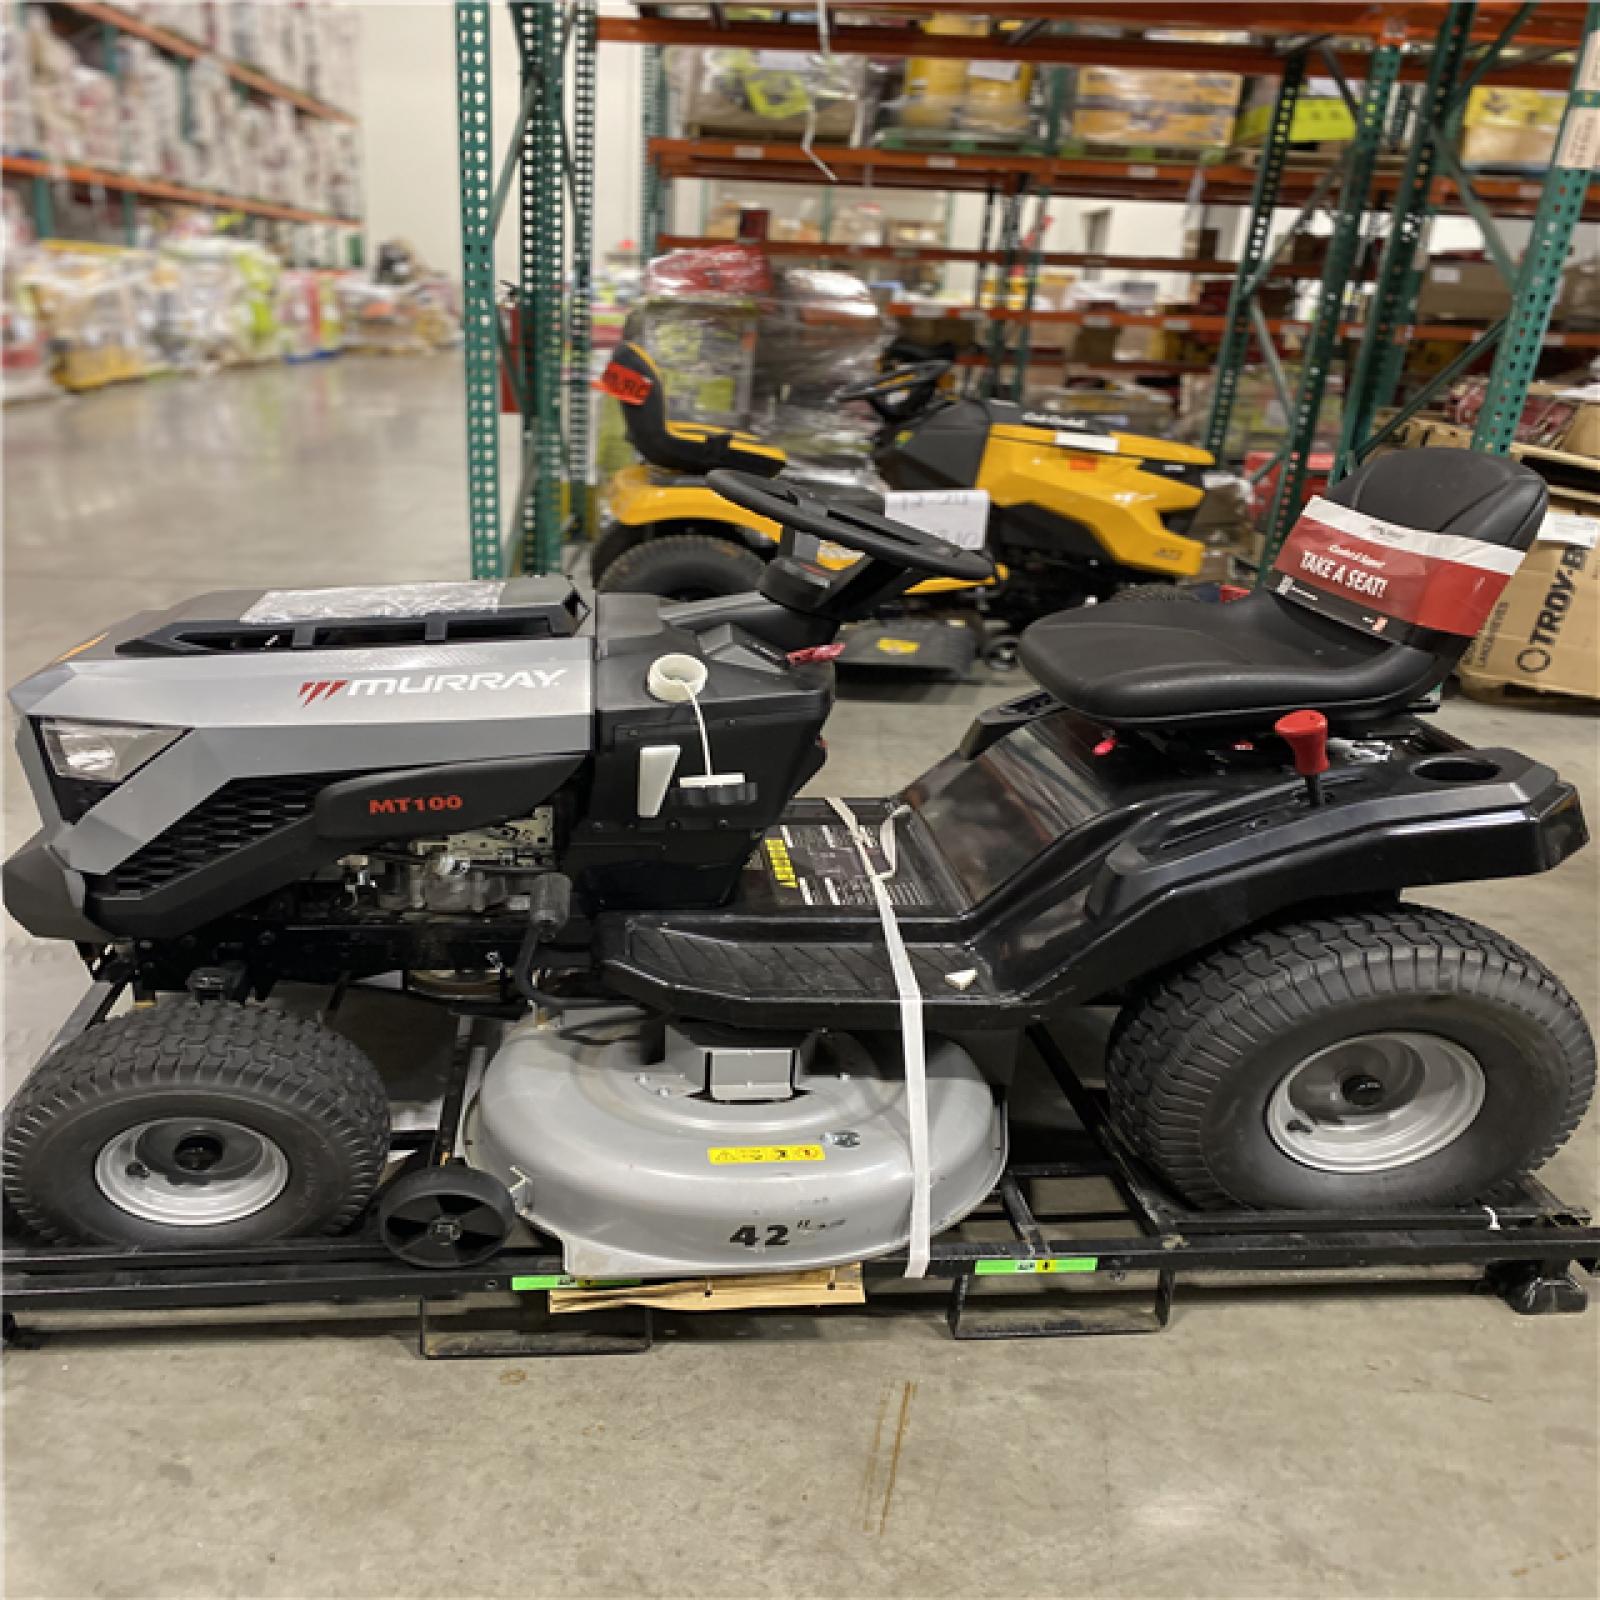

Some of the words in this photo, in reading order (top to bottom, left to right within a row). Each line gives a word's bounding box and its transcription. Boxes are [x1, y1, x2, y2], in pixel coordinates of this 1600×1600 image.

[1301, 548, 1336, 578] TAKE
[1332, 564, 1346, 584] A
[347, 668, 568, 696] MURRAY
[368, 794, 464, 816] MT100
